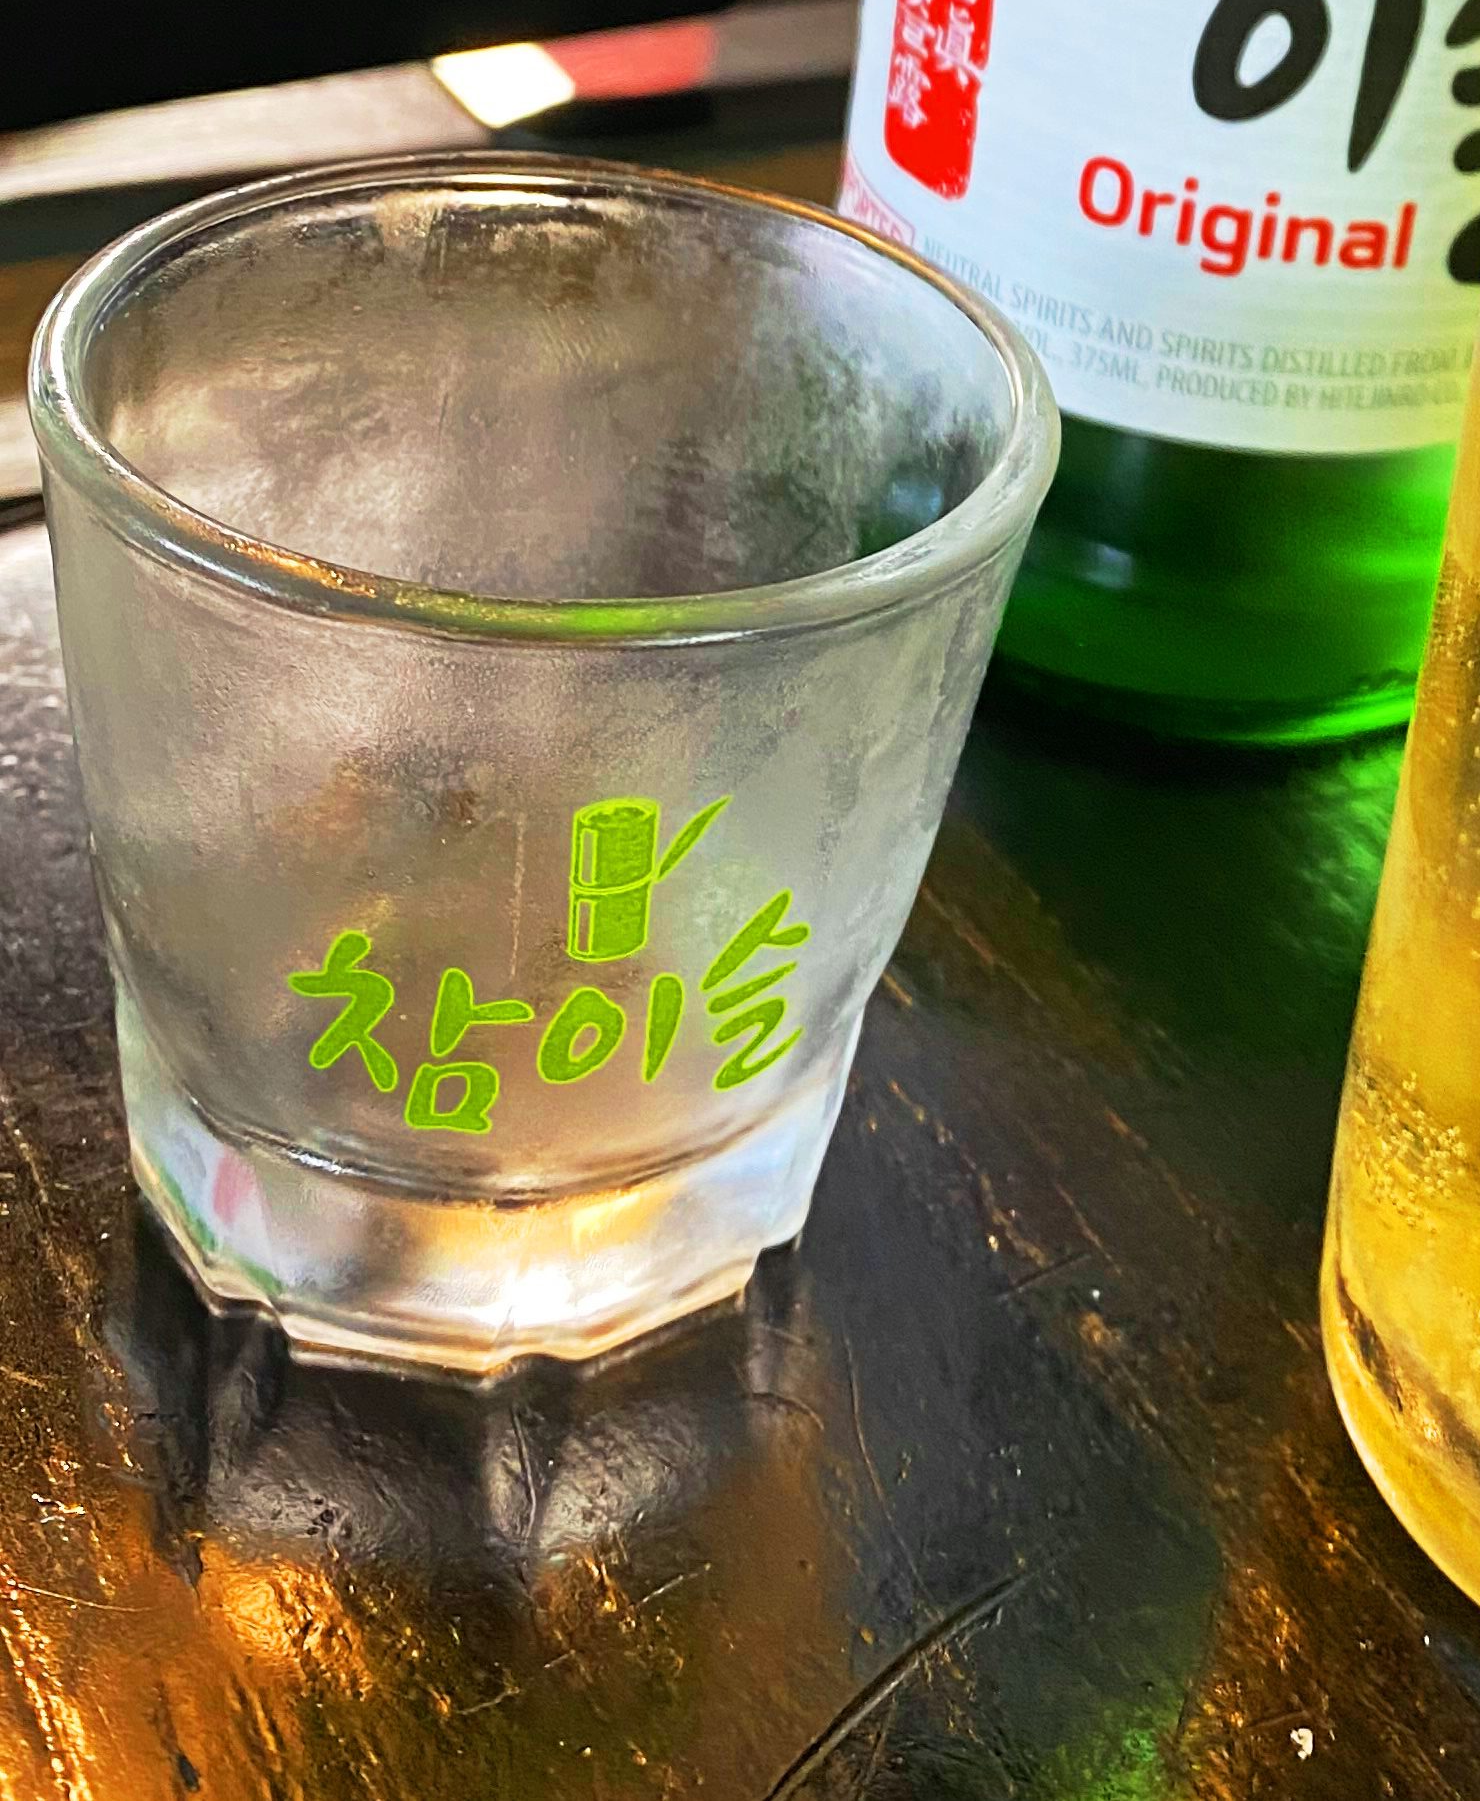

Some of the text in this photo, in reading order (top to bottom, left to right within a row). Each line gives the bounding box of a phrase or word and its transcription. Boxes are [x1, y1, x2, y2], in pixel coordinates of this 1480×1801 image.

[1078, 155, 1418, 277] Original
[1010, 281, 1093, 335] SPIRITS
[1099, 313, 1154, 352] AND
[1159, 329, 1255, 371] SPIRITS
[1260, 345, 1389, 379] DISTILLED
[1157, 362, 1280, 408] PRODUCED
[288, 888, 810, 1134] 참이슬
